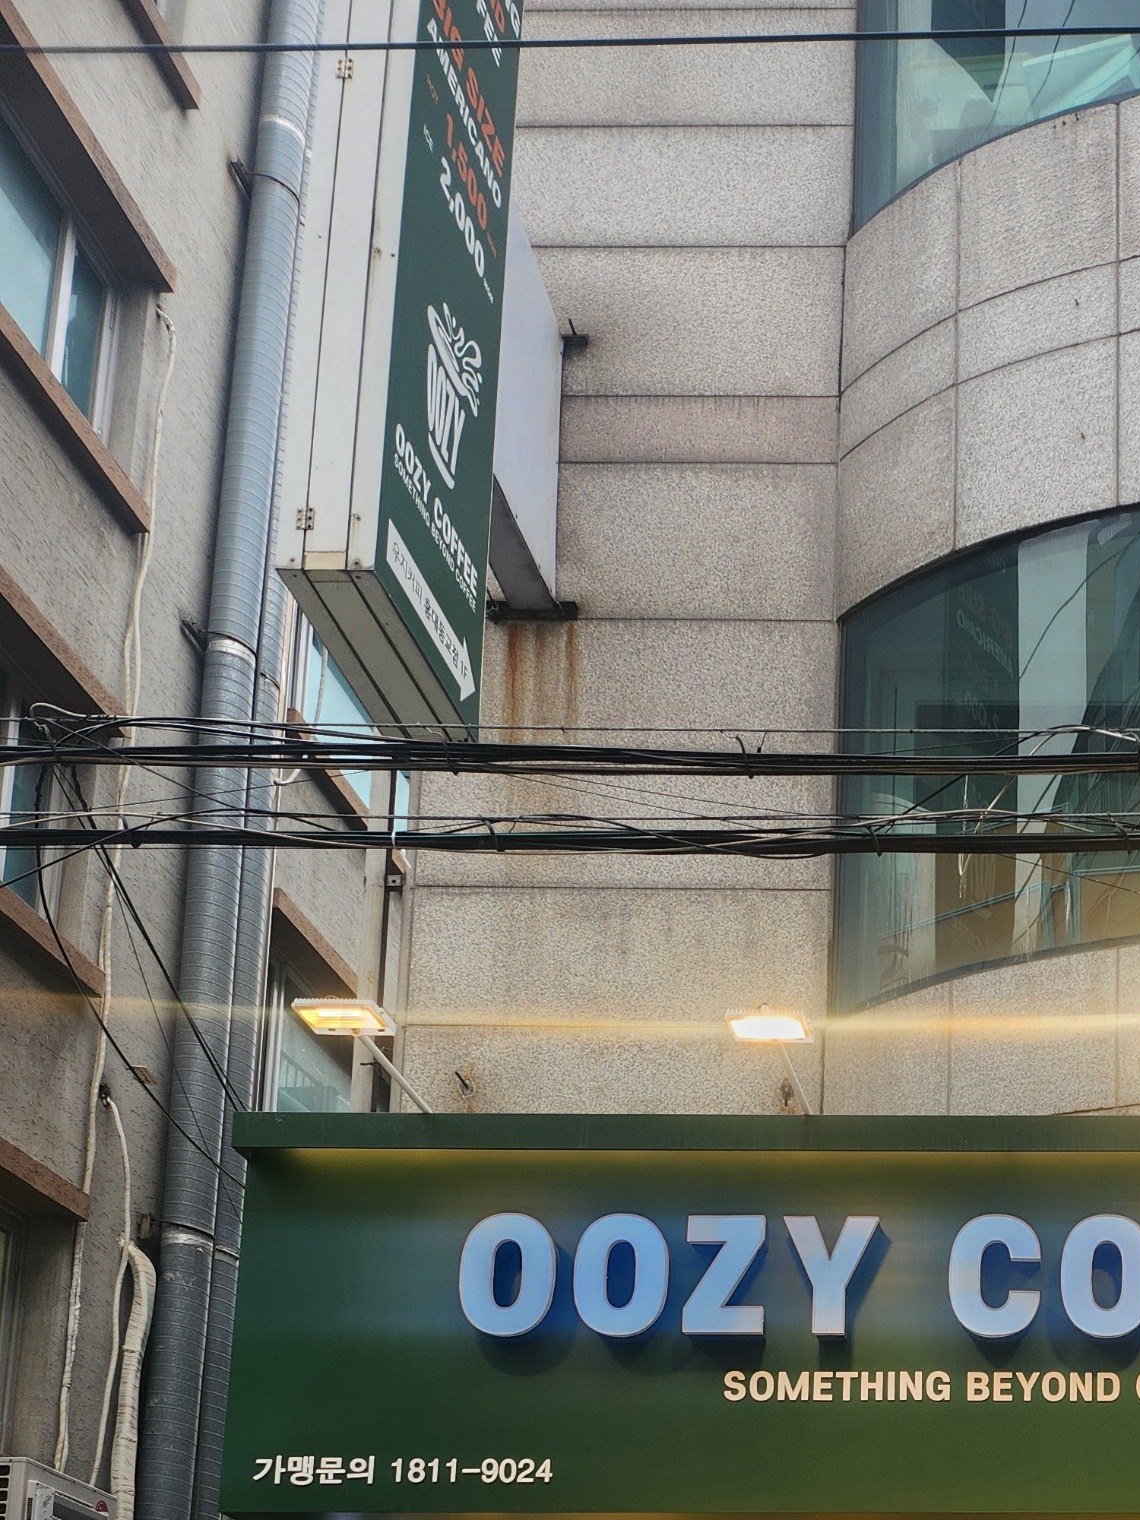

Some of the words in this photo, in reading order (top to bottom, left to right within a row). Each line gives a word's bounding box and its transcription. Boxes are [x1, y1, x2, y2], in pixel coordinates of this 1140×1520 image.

[427, 18, 502, 208] AMERICANO
[446, 112, 488, 230] 1,500
[466, 67, 505, 177] SIZE
[440, 157, 485, 278] 2,000
[427, 343, 466, 476] OOZY
[394, 453, 431, 528] SOMETHING
[431, 521, 455, 573] BEYOND
[455, 569, 477, 614] COFFEE
[395, 423, 432, 505] OOZY
[434, 497, 479, 598] COFFEE
[460, 660, 469, 680] 1F
[459, 1212, 881, 1339] OOZY
[722, 1370, 951, 1402] SOMETHING
[966, 1370, 1121, 1402] BEYOND
[252, 1455, 375, 1486] 가맹문의
[391, 1457, 554, 1485] 1811-9024
